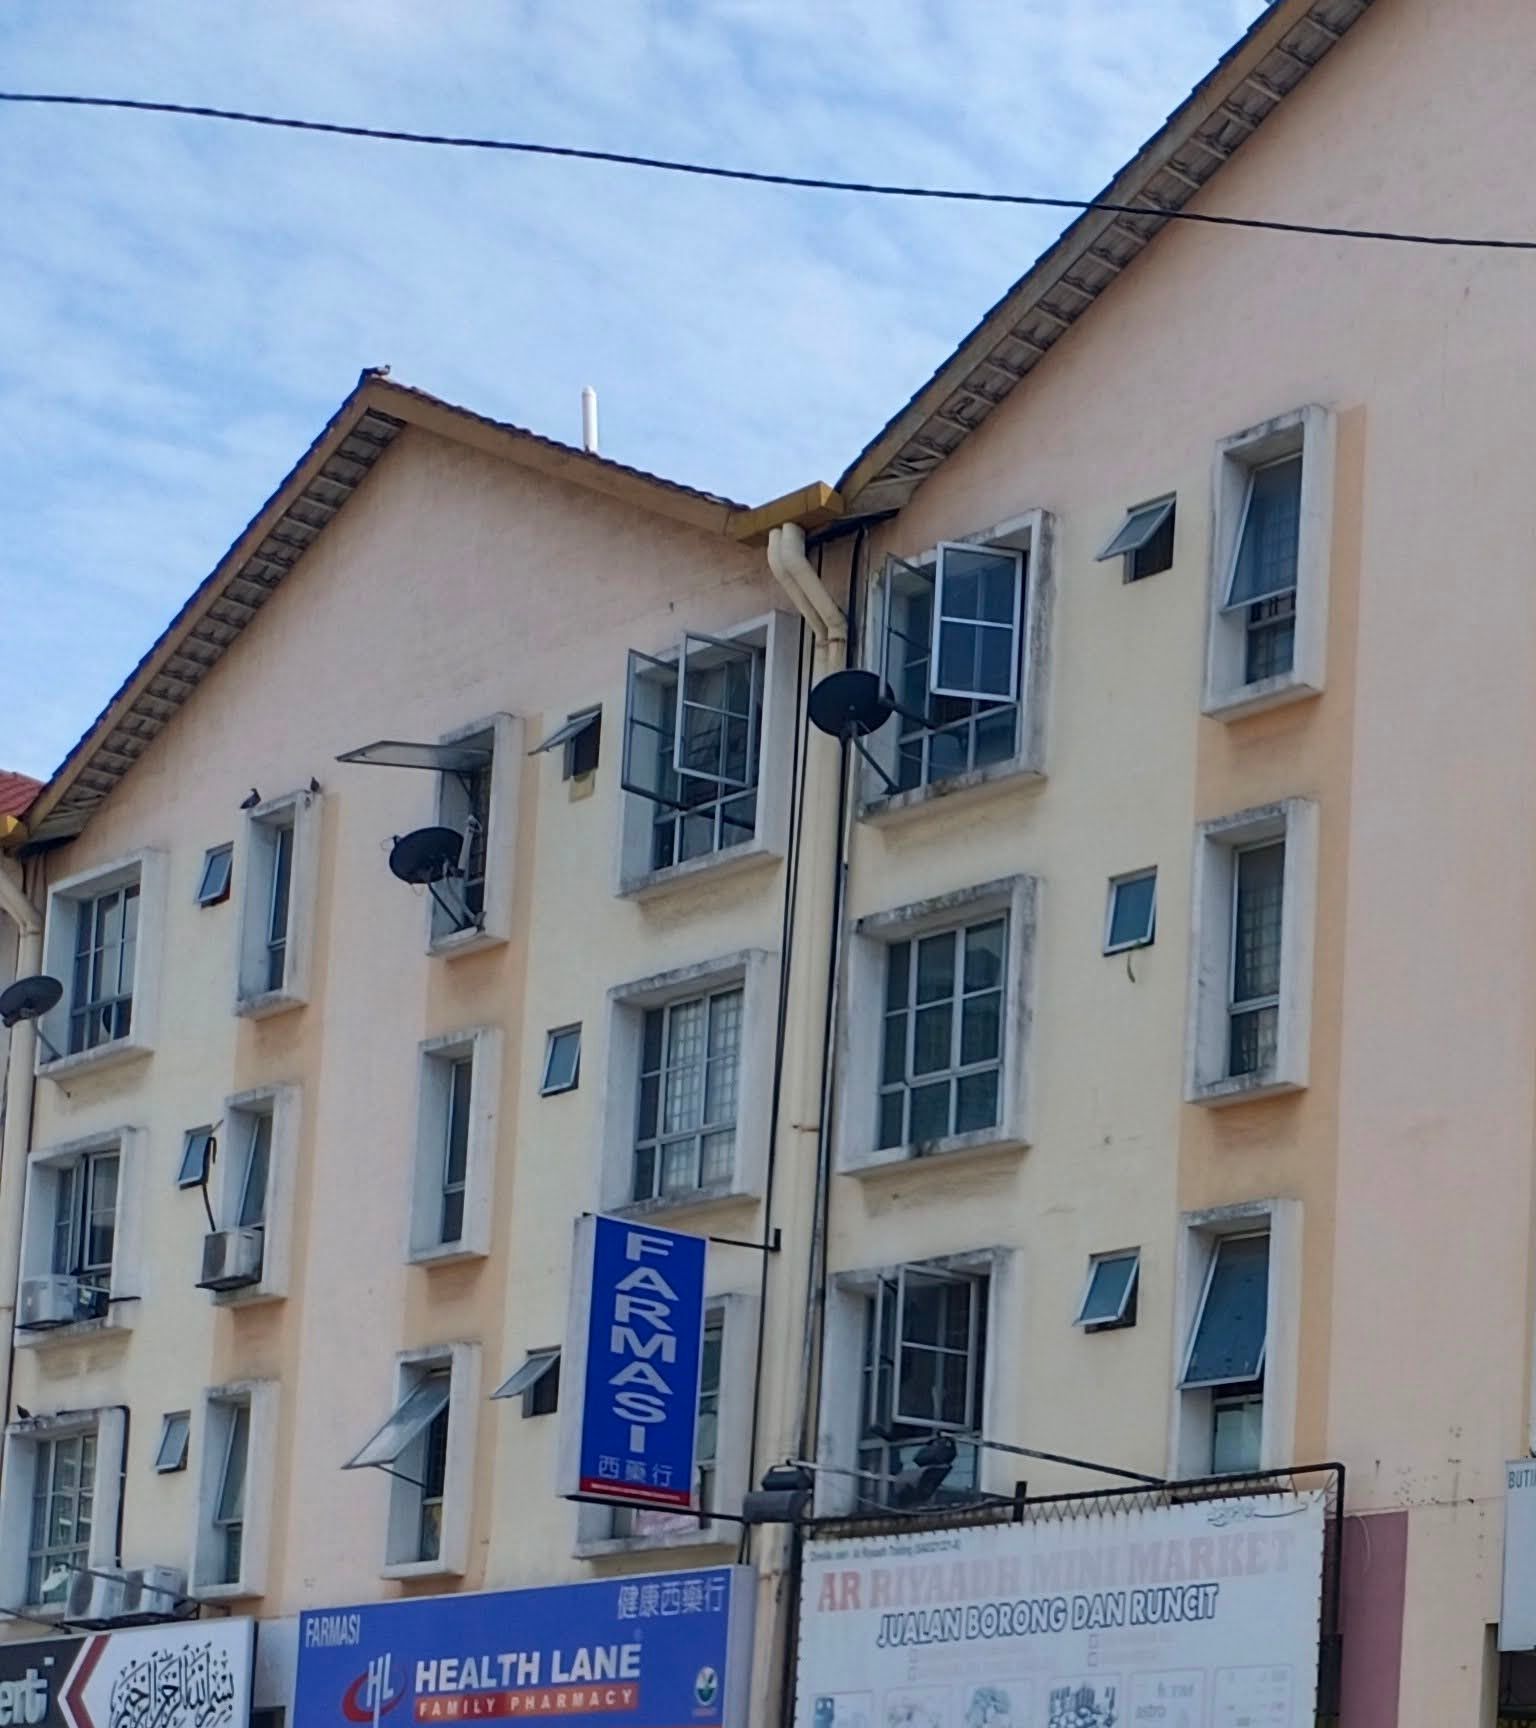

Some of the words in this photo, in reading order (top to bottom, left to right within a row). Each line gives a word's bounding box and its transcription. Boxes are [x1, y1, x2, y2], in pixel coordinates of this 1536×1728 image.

[608, 1231, 679, 1453] FARMASI
[817, 1567, 861, 1614] AR
[1031, 1548, 1119, 1598] MINI
[1128, 1528, 1298, 1589] MARKET
[305, 1614, 360, 1649] FARMASI
[876, 1606, 963, 1649] JUALAN
[964, 1596, 1069, 1643] BORONG
[1071, 1590, 1126, 1631] DAN
[1129, 1582, 1220, 1626] RUNCIT
[415, 1651, 540, 1694] HEALTH
[551, 1643, 642, 1684] LANE
[419, 1697, 496, 1718] FAMILY
[510, 1688, 635, 1711] PHARMACY
